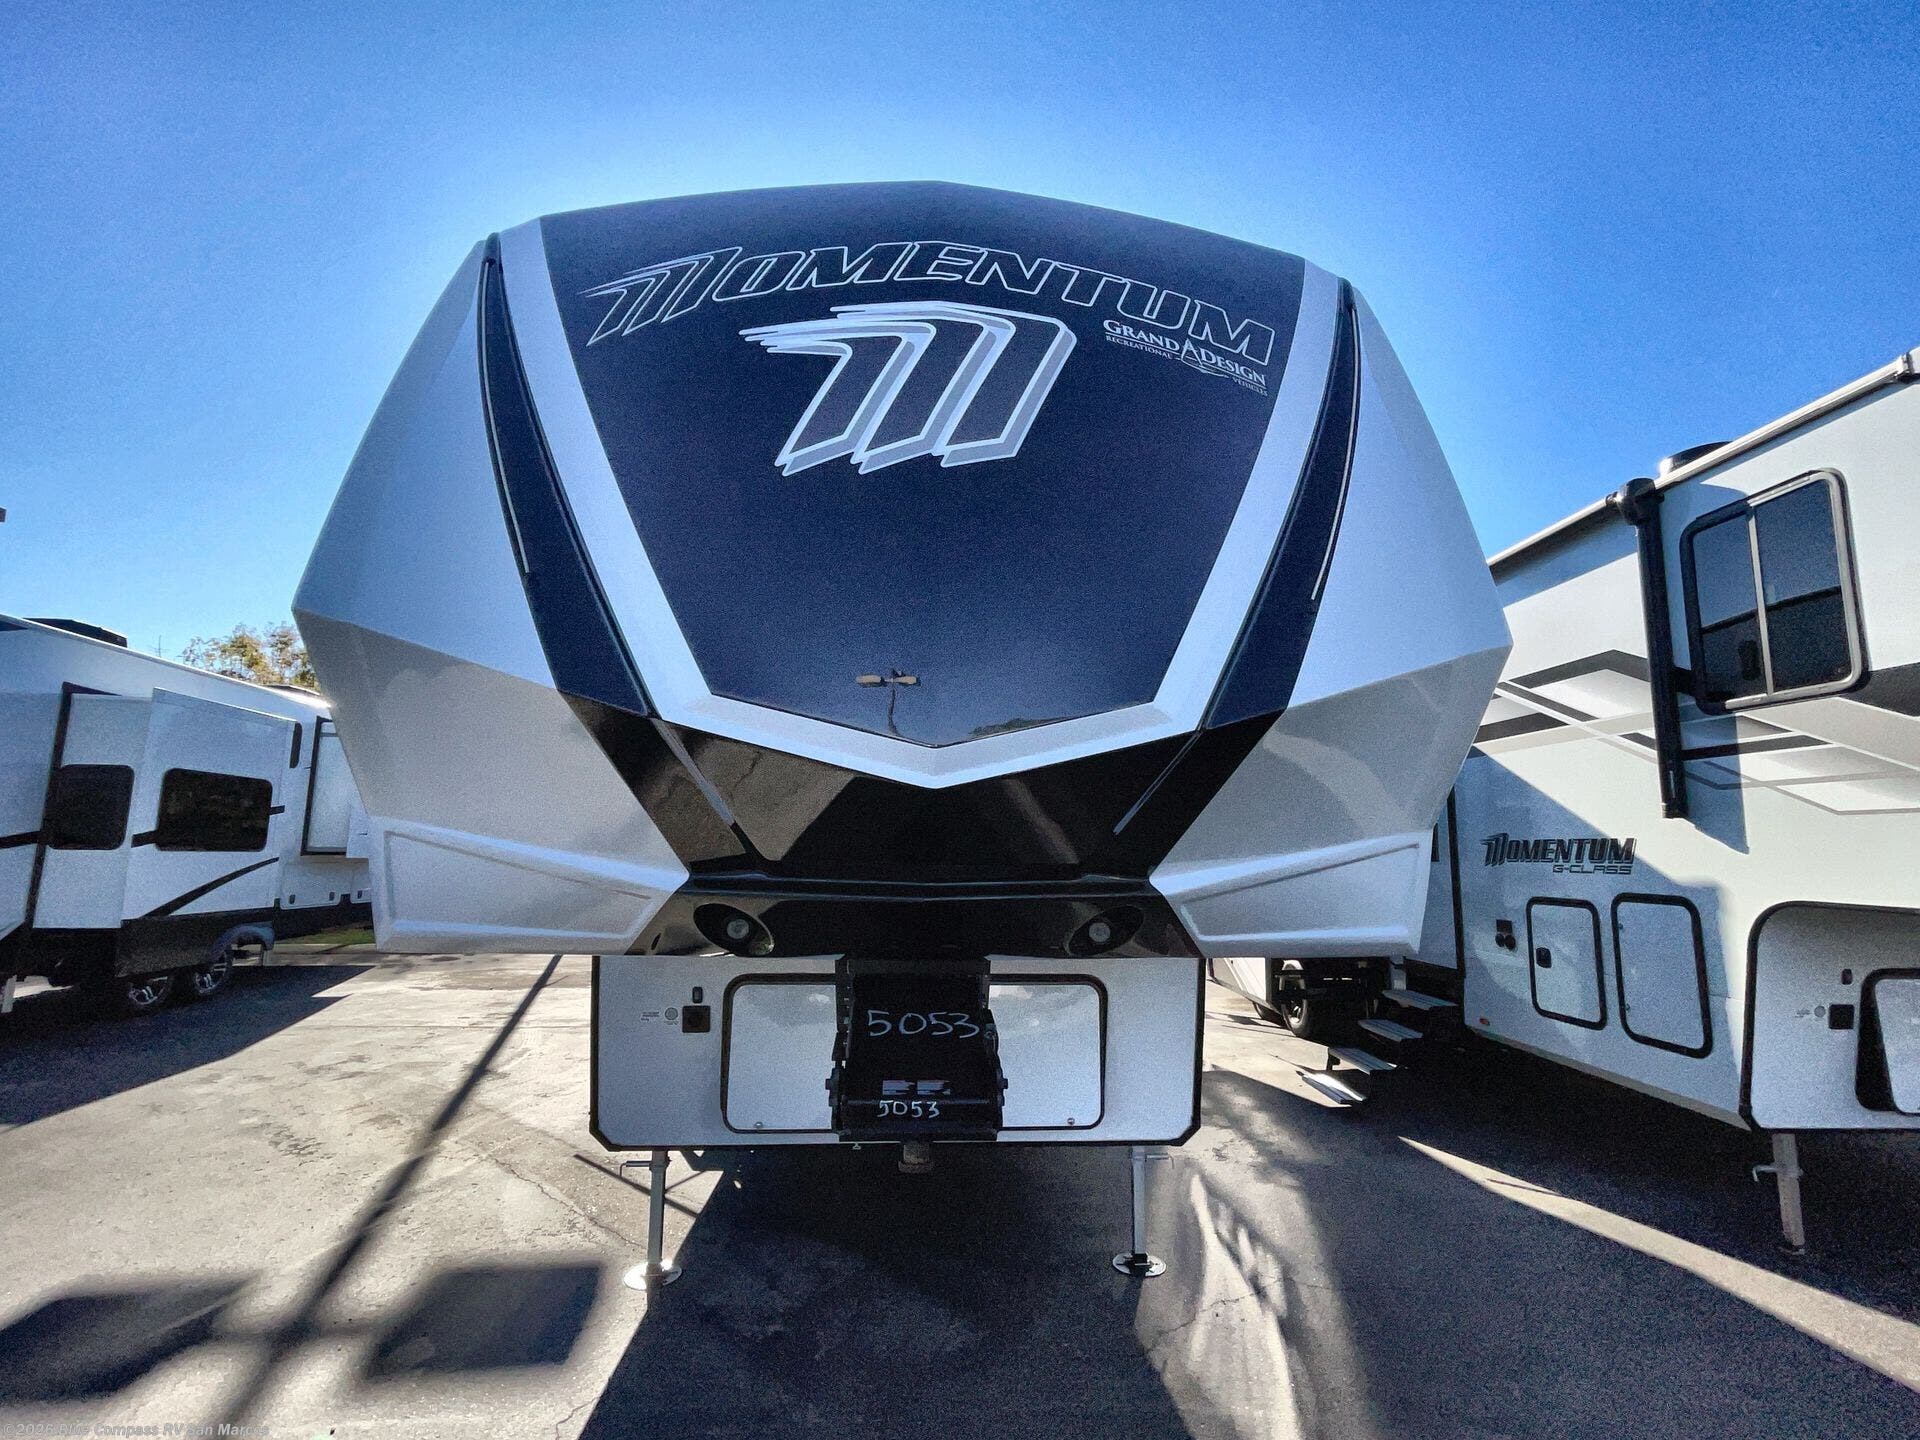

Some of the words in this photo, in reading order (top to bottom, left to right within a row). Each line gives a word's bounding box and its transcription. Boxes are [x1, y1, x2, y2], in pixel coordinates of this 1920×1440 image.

[578, 241, 1276, 366] MOMENTUM
[1103, 319, 1180, 351] GRAND
[1200, 348, 1266, 387] DESIGN
[1105, 335, 1174, 360] RECREATIONAL
[1481, 833, 1637, 866] MOMENTUM
[1553, 864, 1633, 875] G-CLASS
[867, 1009, 980, 1038] 5053
[877, 1100, 940, 1118] 5053
